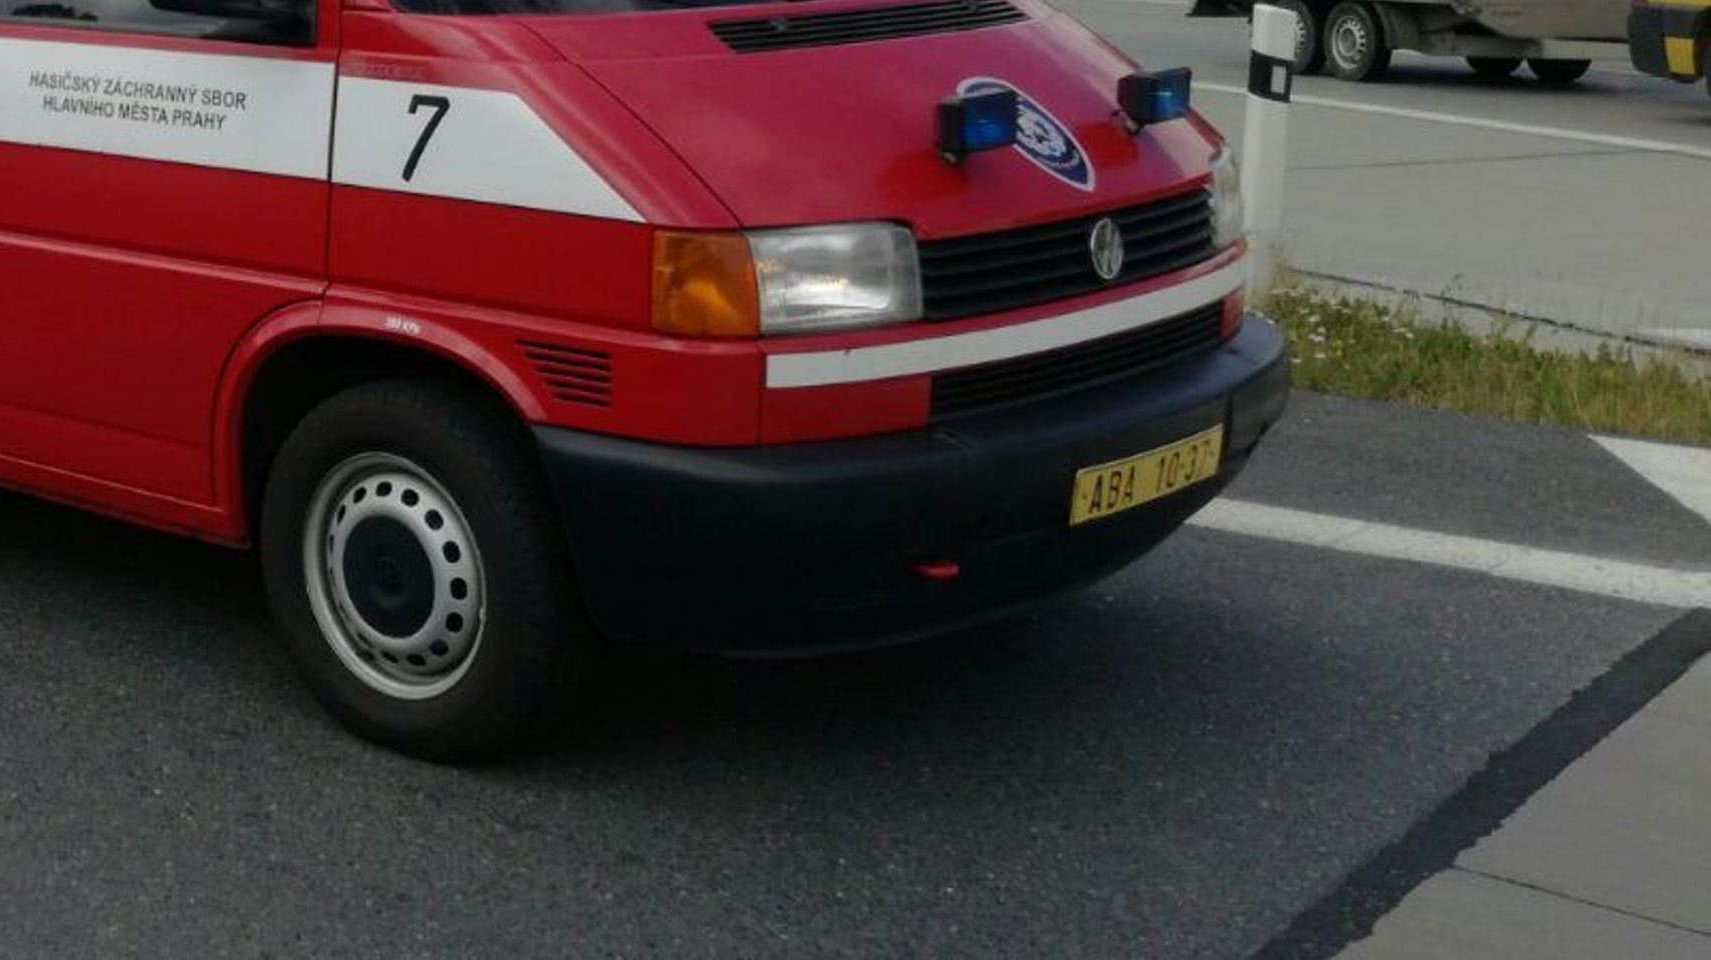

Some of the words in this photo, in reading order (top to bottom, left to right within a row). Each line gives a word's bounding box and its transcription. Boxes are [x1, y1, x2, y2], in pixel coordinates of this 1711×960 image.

[28, 71, 101, 93] HASIČSKÝ
[103, 76, 197, 102] ZÁCHRANNÝ
[201, 90, 247, 110] SBOR
[42, 94, 115, 119] HLAVNÍHO
[171, 109, 227, 130] PRAHY
[402, 93, 451, 182] 7
[1088, 464, 1136, 515] ABA
